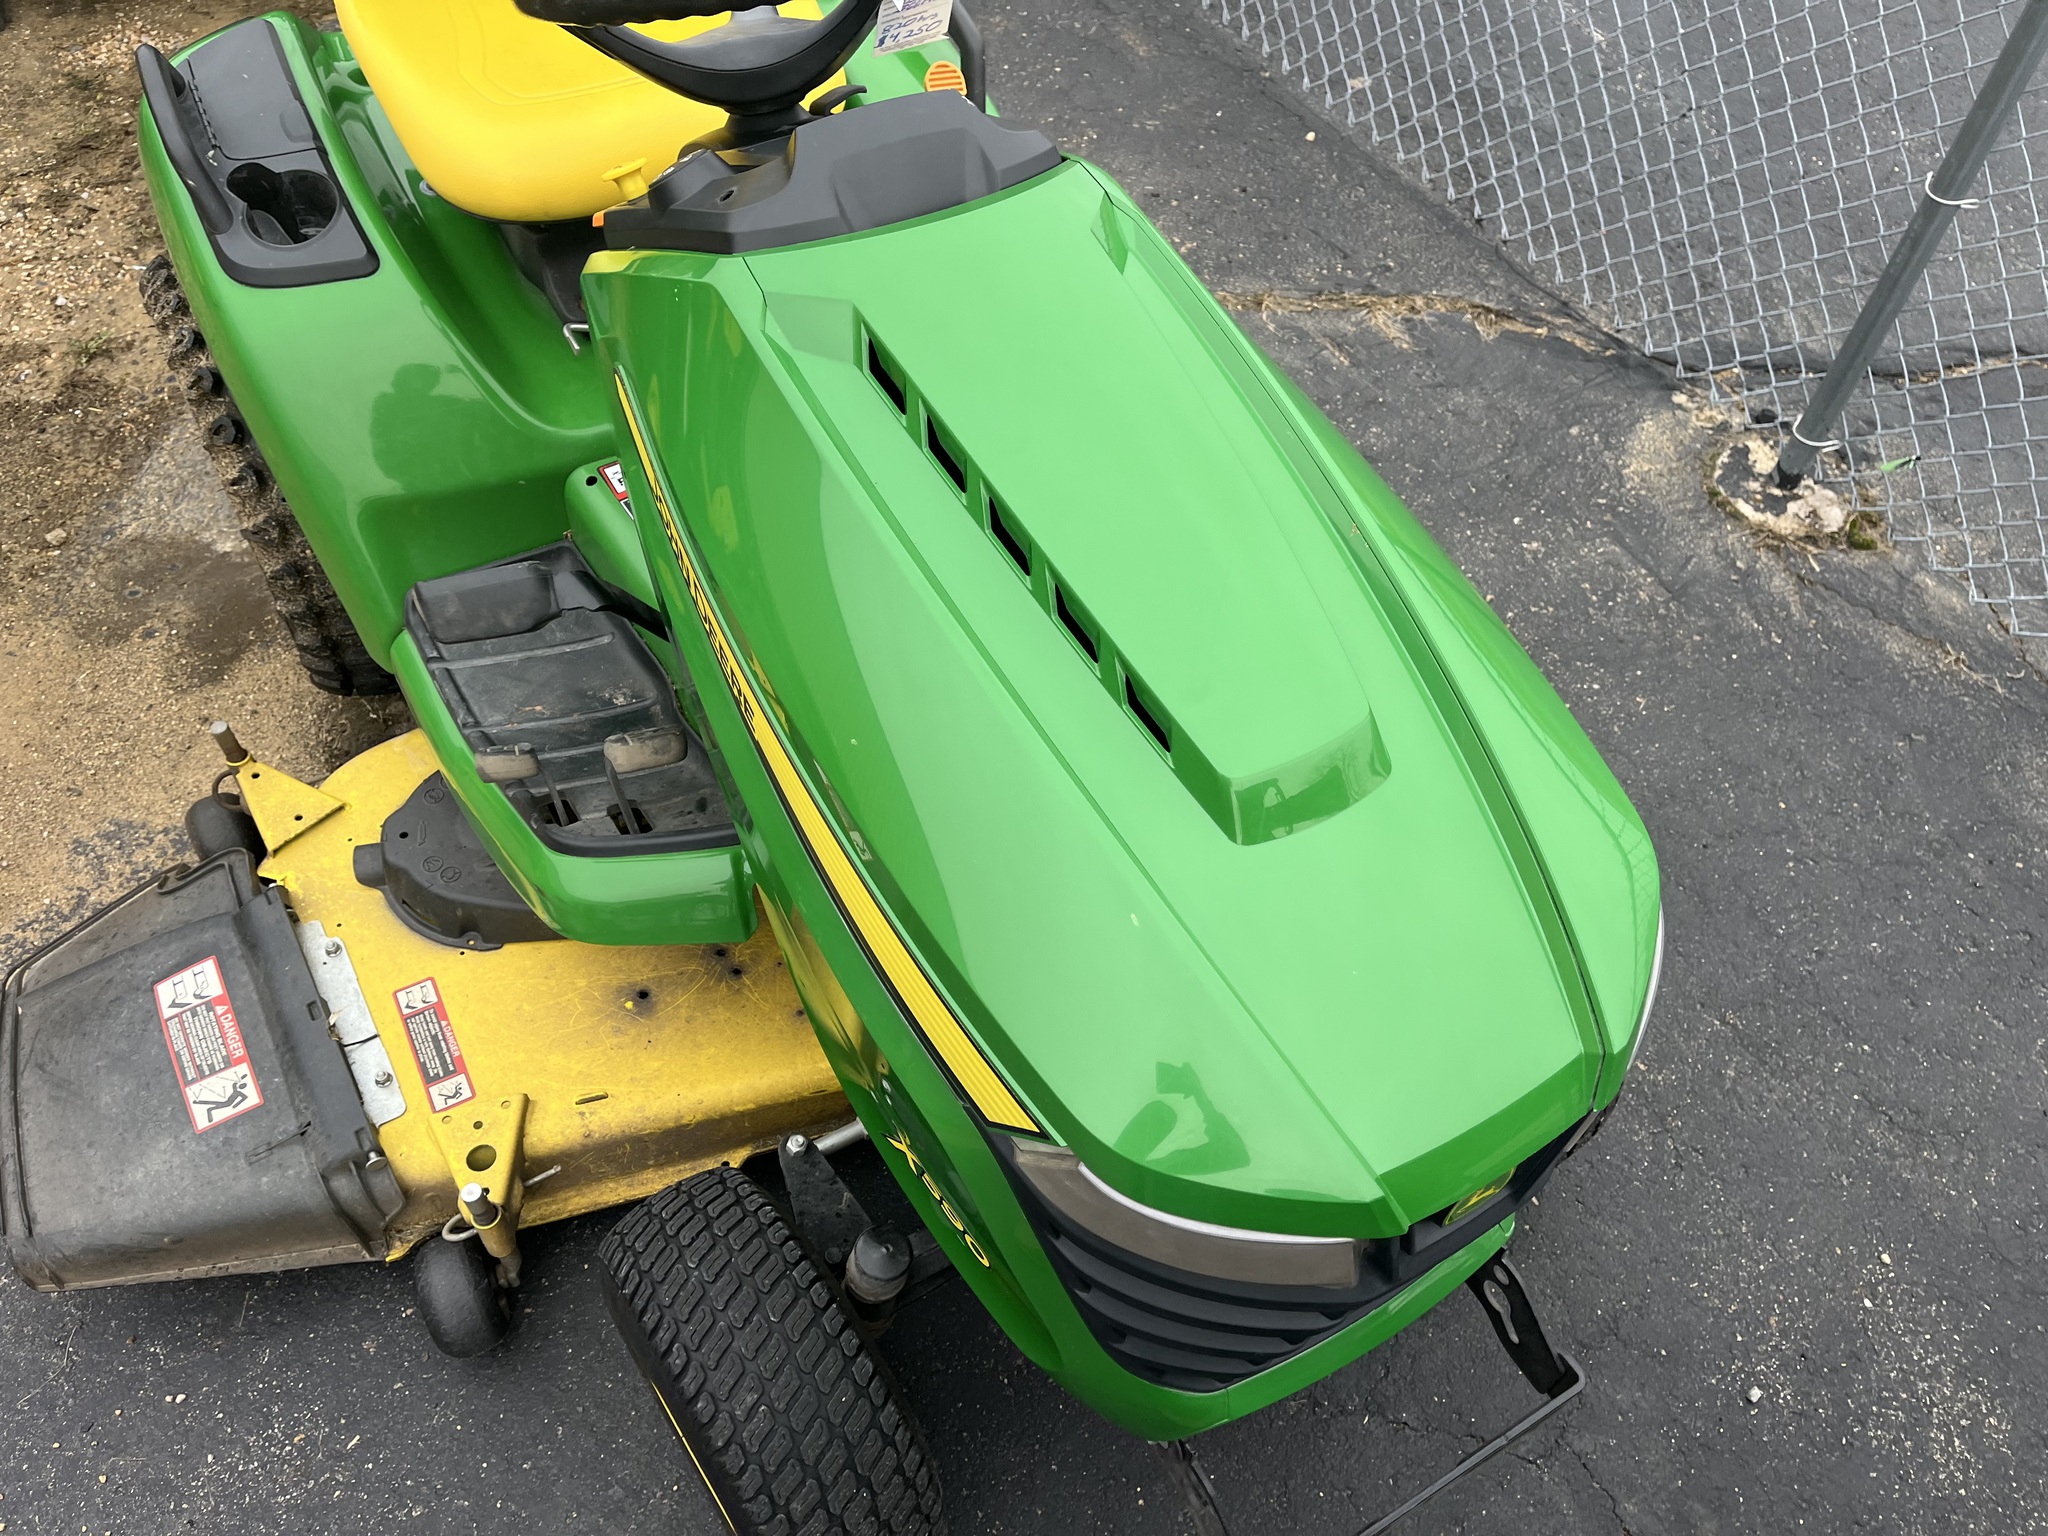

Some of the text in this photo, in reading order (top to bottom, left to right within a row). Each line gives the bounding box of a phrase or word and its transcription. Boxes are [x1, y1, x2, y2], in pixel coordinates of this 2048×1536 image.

[693, 577, 756, 735] DEERE
[220, 1013, 244, 1059] DANGER
[443, 1024, 461, 1058] DANGER
